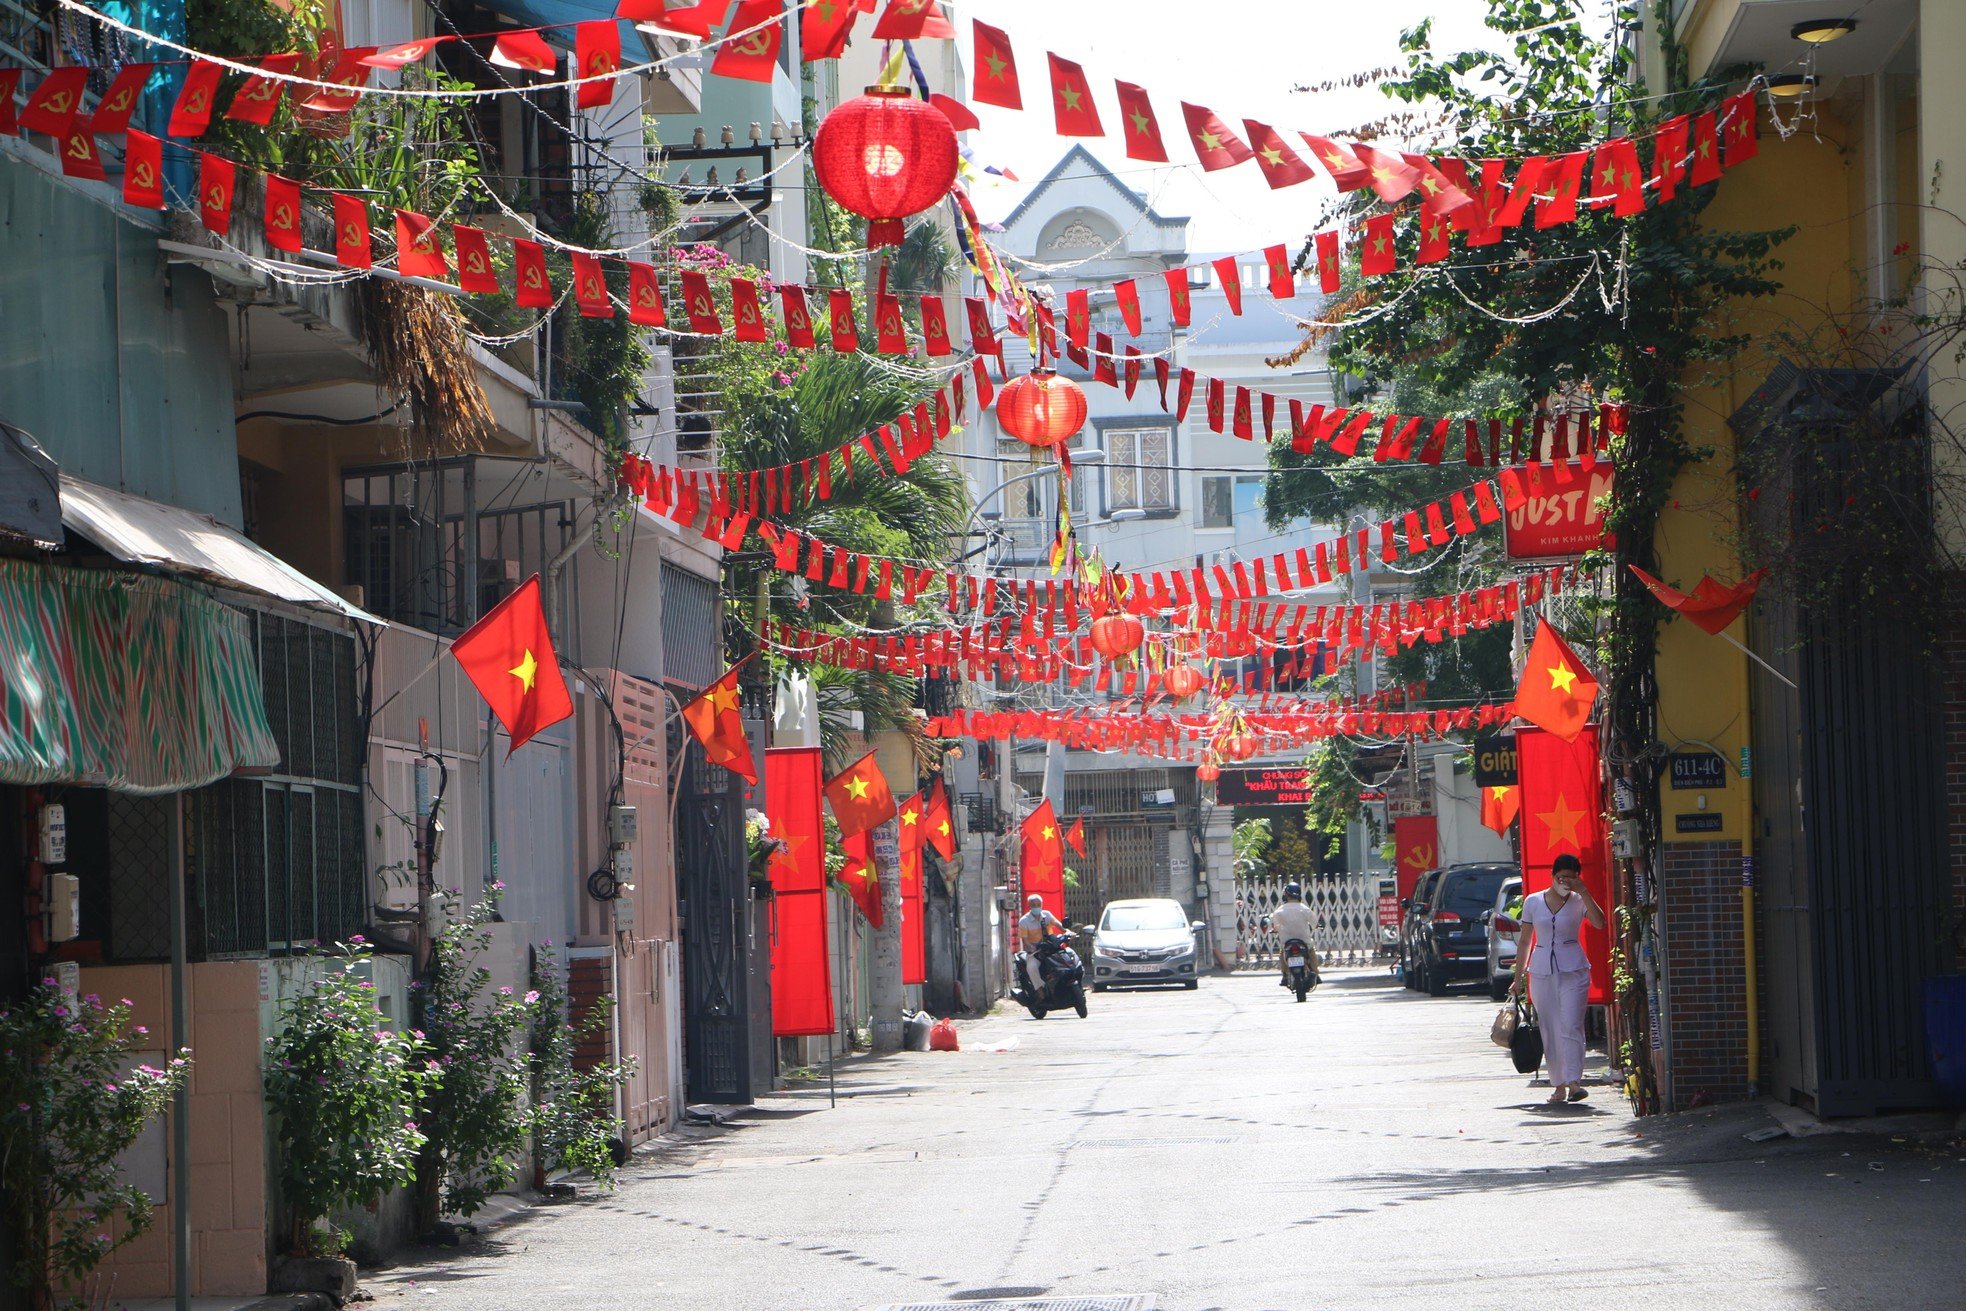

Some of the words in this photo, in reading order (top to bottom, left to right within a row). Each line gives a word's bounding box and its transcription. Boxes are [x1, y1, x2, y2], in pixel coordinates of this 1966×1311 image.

[1511, 490, 1585, 531] JUST
[1540, 537, 1559, 545] KIM
[1480, 745, 1518, 778] GIẶT
[1675, 757, 1721, 776] 611-4C
